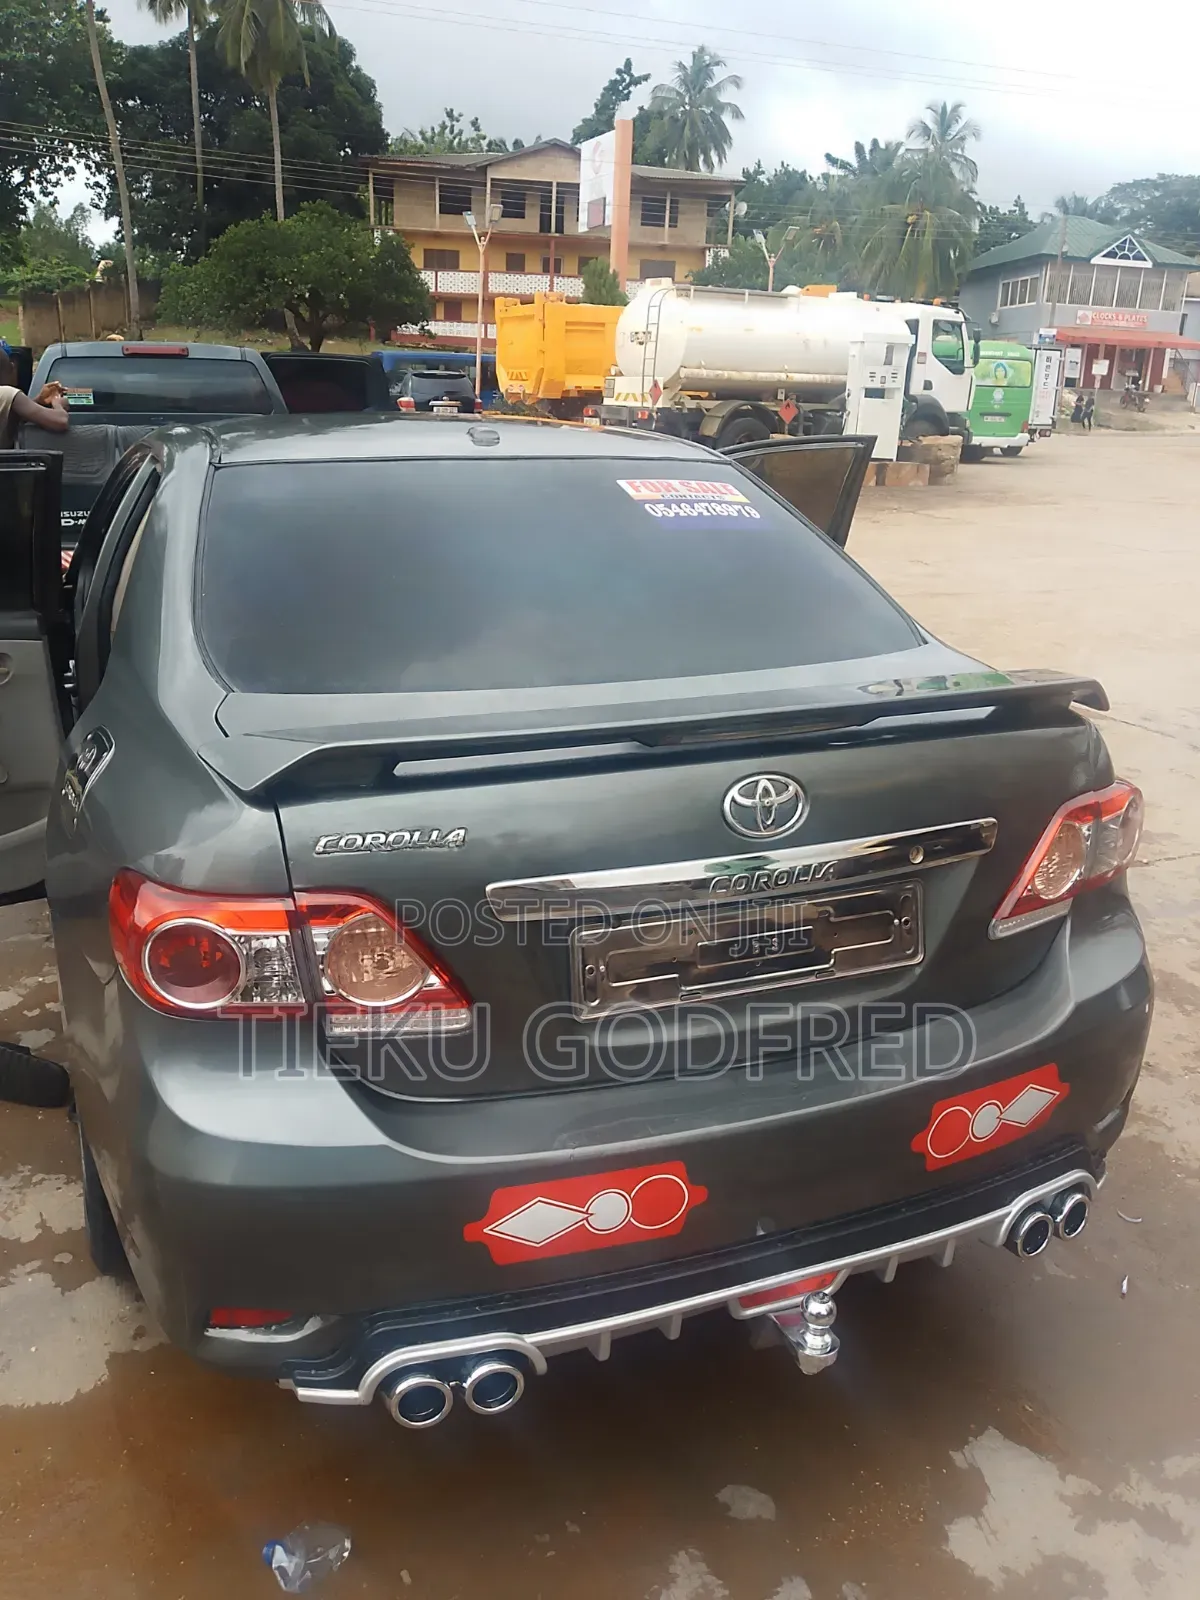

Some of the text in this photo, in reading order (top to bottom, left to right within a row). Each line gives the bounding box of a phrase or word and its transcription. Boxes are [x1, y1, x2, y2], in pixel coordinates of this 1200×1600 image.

[625, 480, 739, 496] FOR SALE
[315, 827, 468, 855] COROLLA
[708, 860, 839, 894] COROLLA
